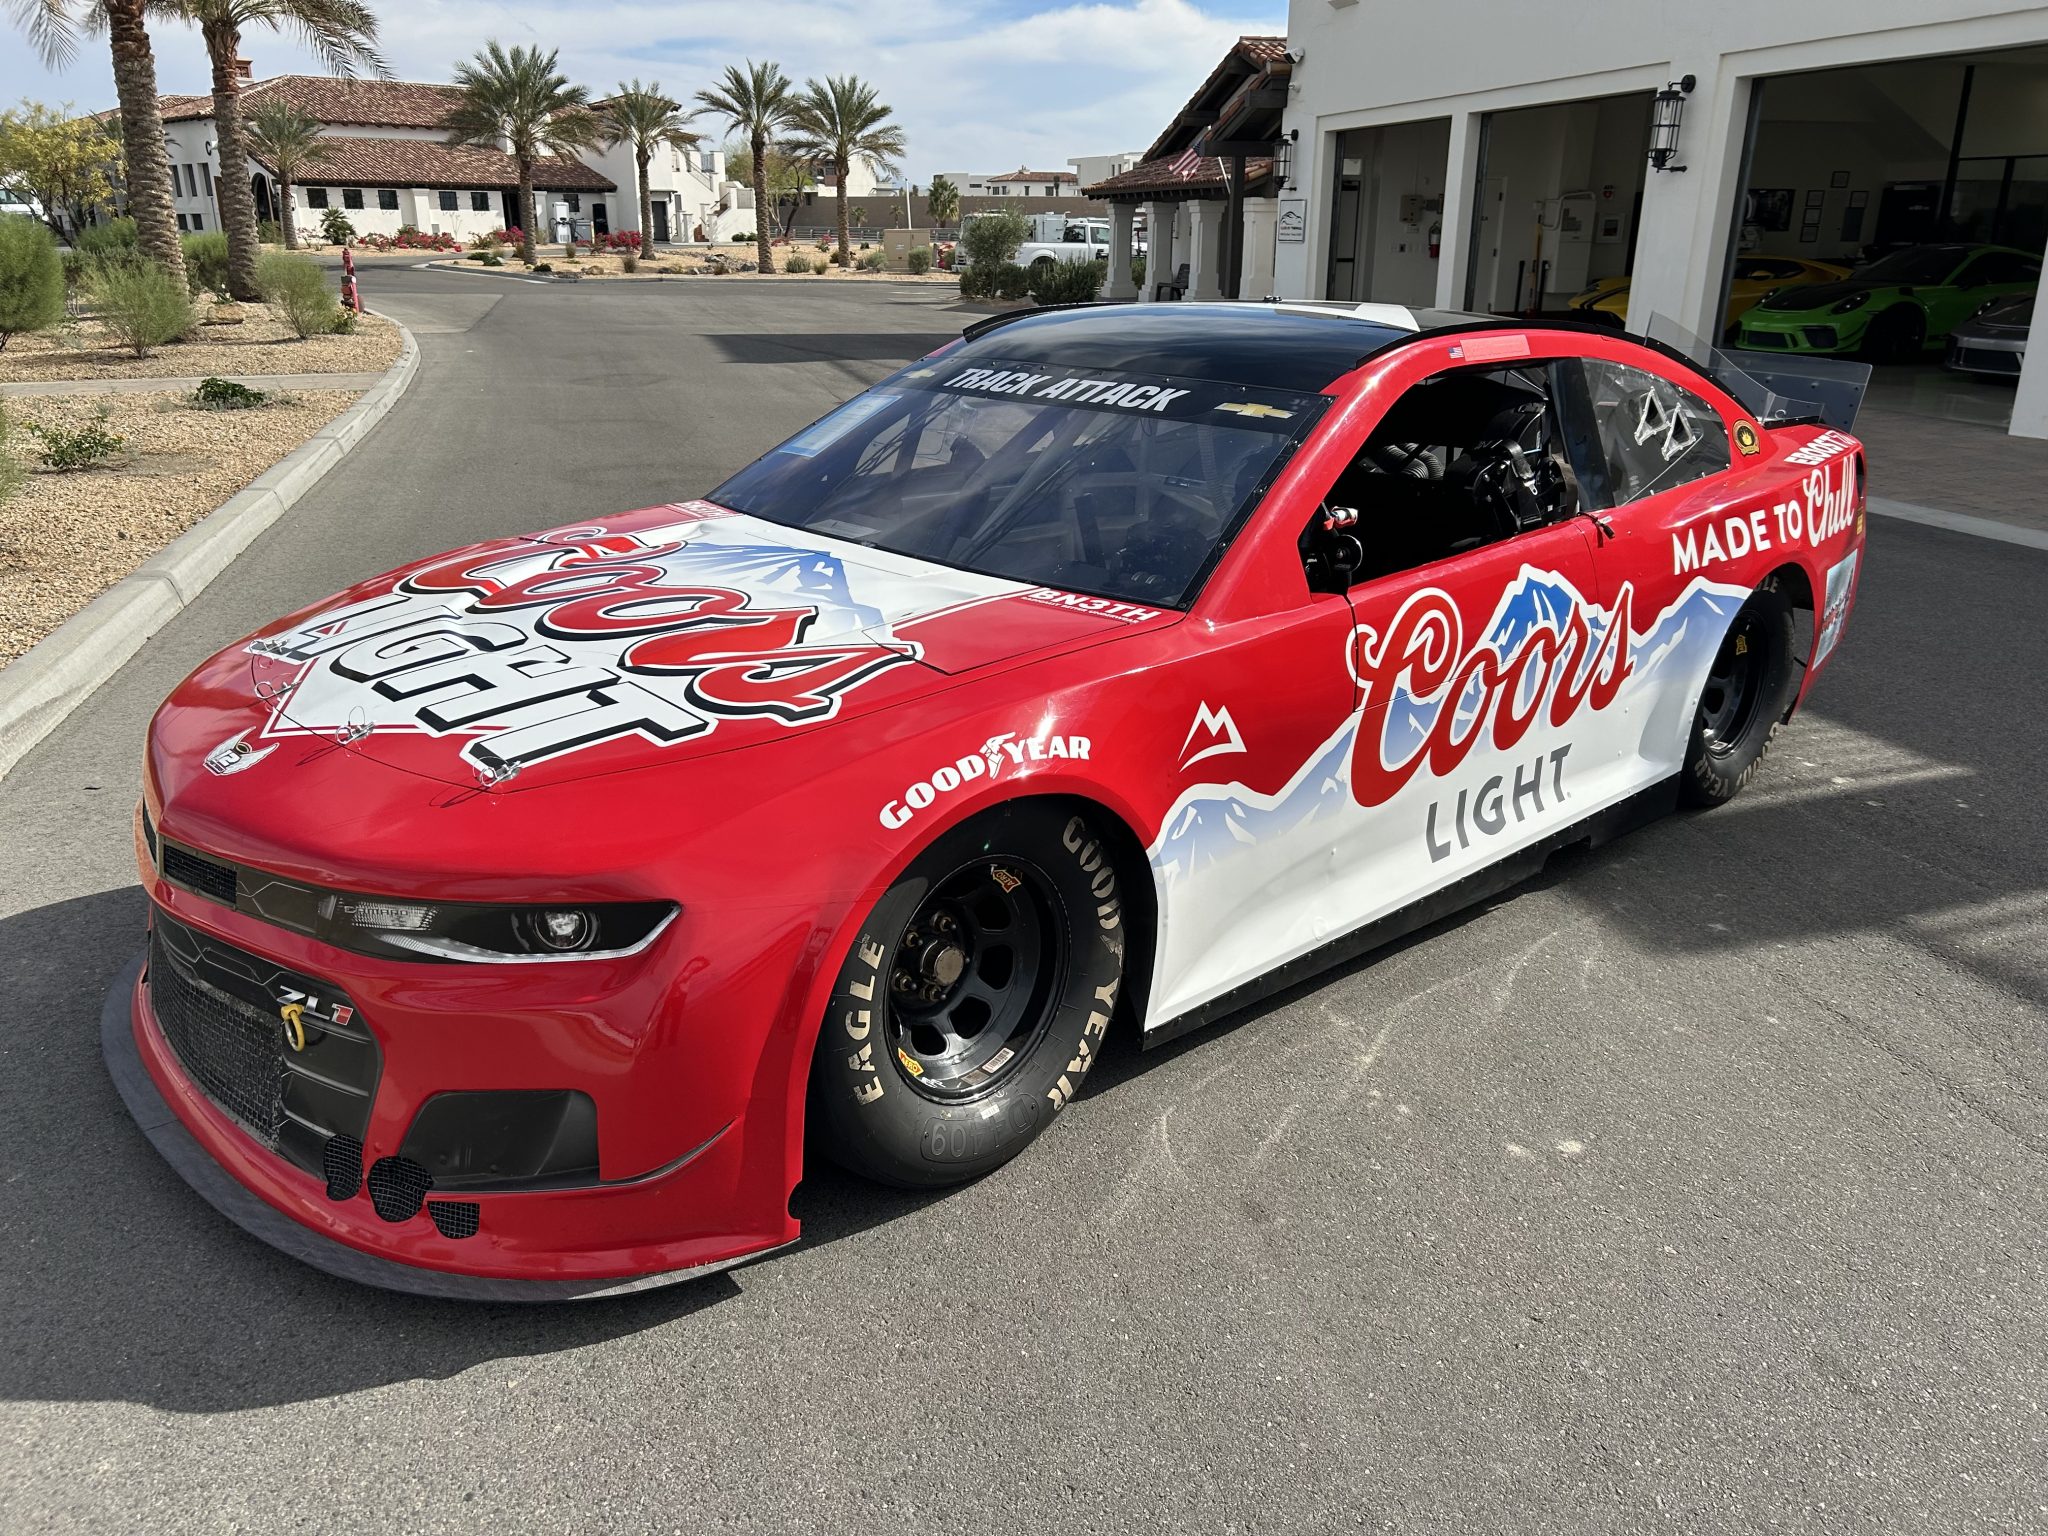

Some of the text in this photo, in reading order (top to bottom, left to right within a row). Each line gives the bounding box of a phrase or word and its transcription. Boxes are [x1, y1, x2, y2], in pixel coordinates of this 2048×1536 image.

[943, 369, 1191, 412] TRACK ATTACK
[1672, 454, 1855, 576] MADE TO Chill
[398, 528, 918, 724] Coors
[1029, 589, 1162, 621] BN3TH
[250, 593, 710, 768] LIGHT
[1346, 581, 1636, 807] Coors
[1426, 743, 1572, 864] LIGHT
[277, 985, 354, 1026] ZL1
[845, 940, 885, 1106] EAGLE
